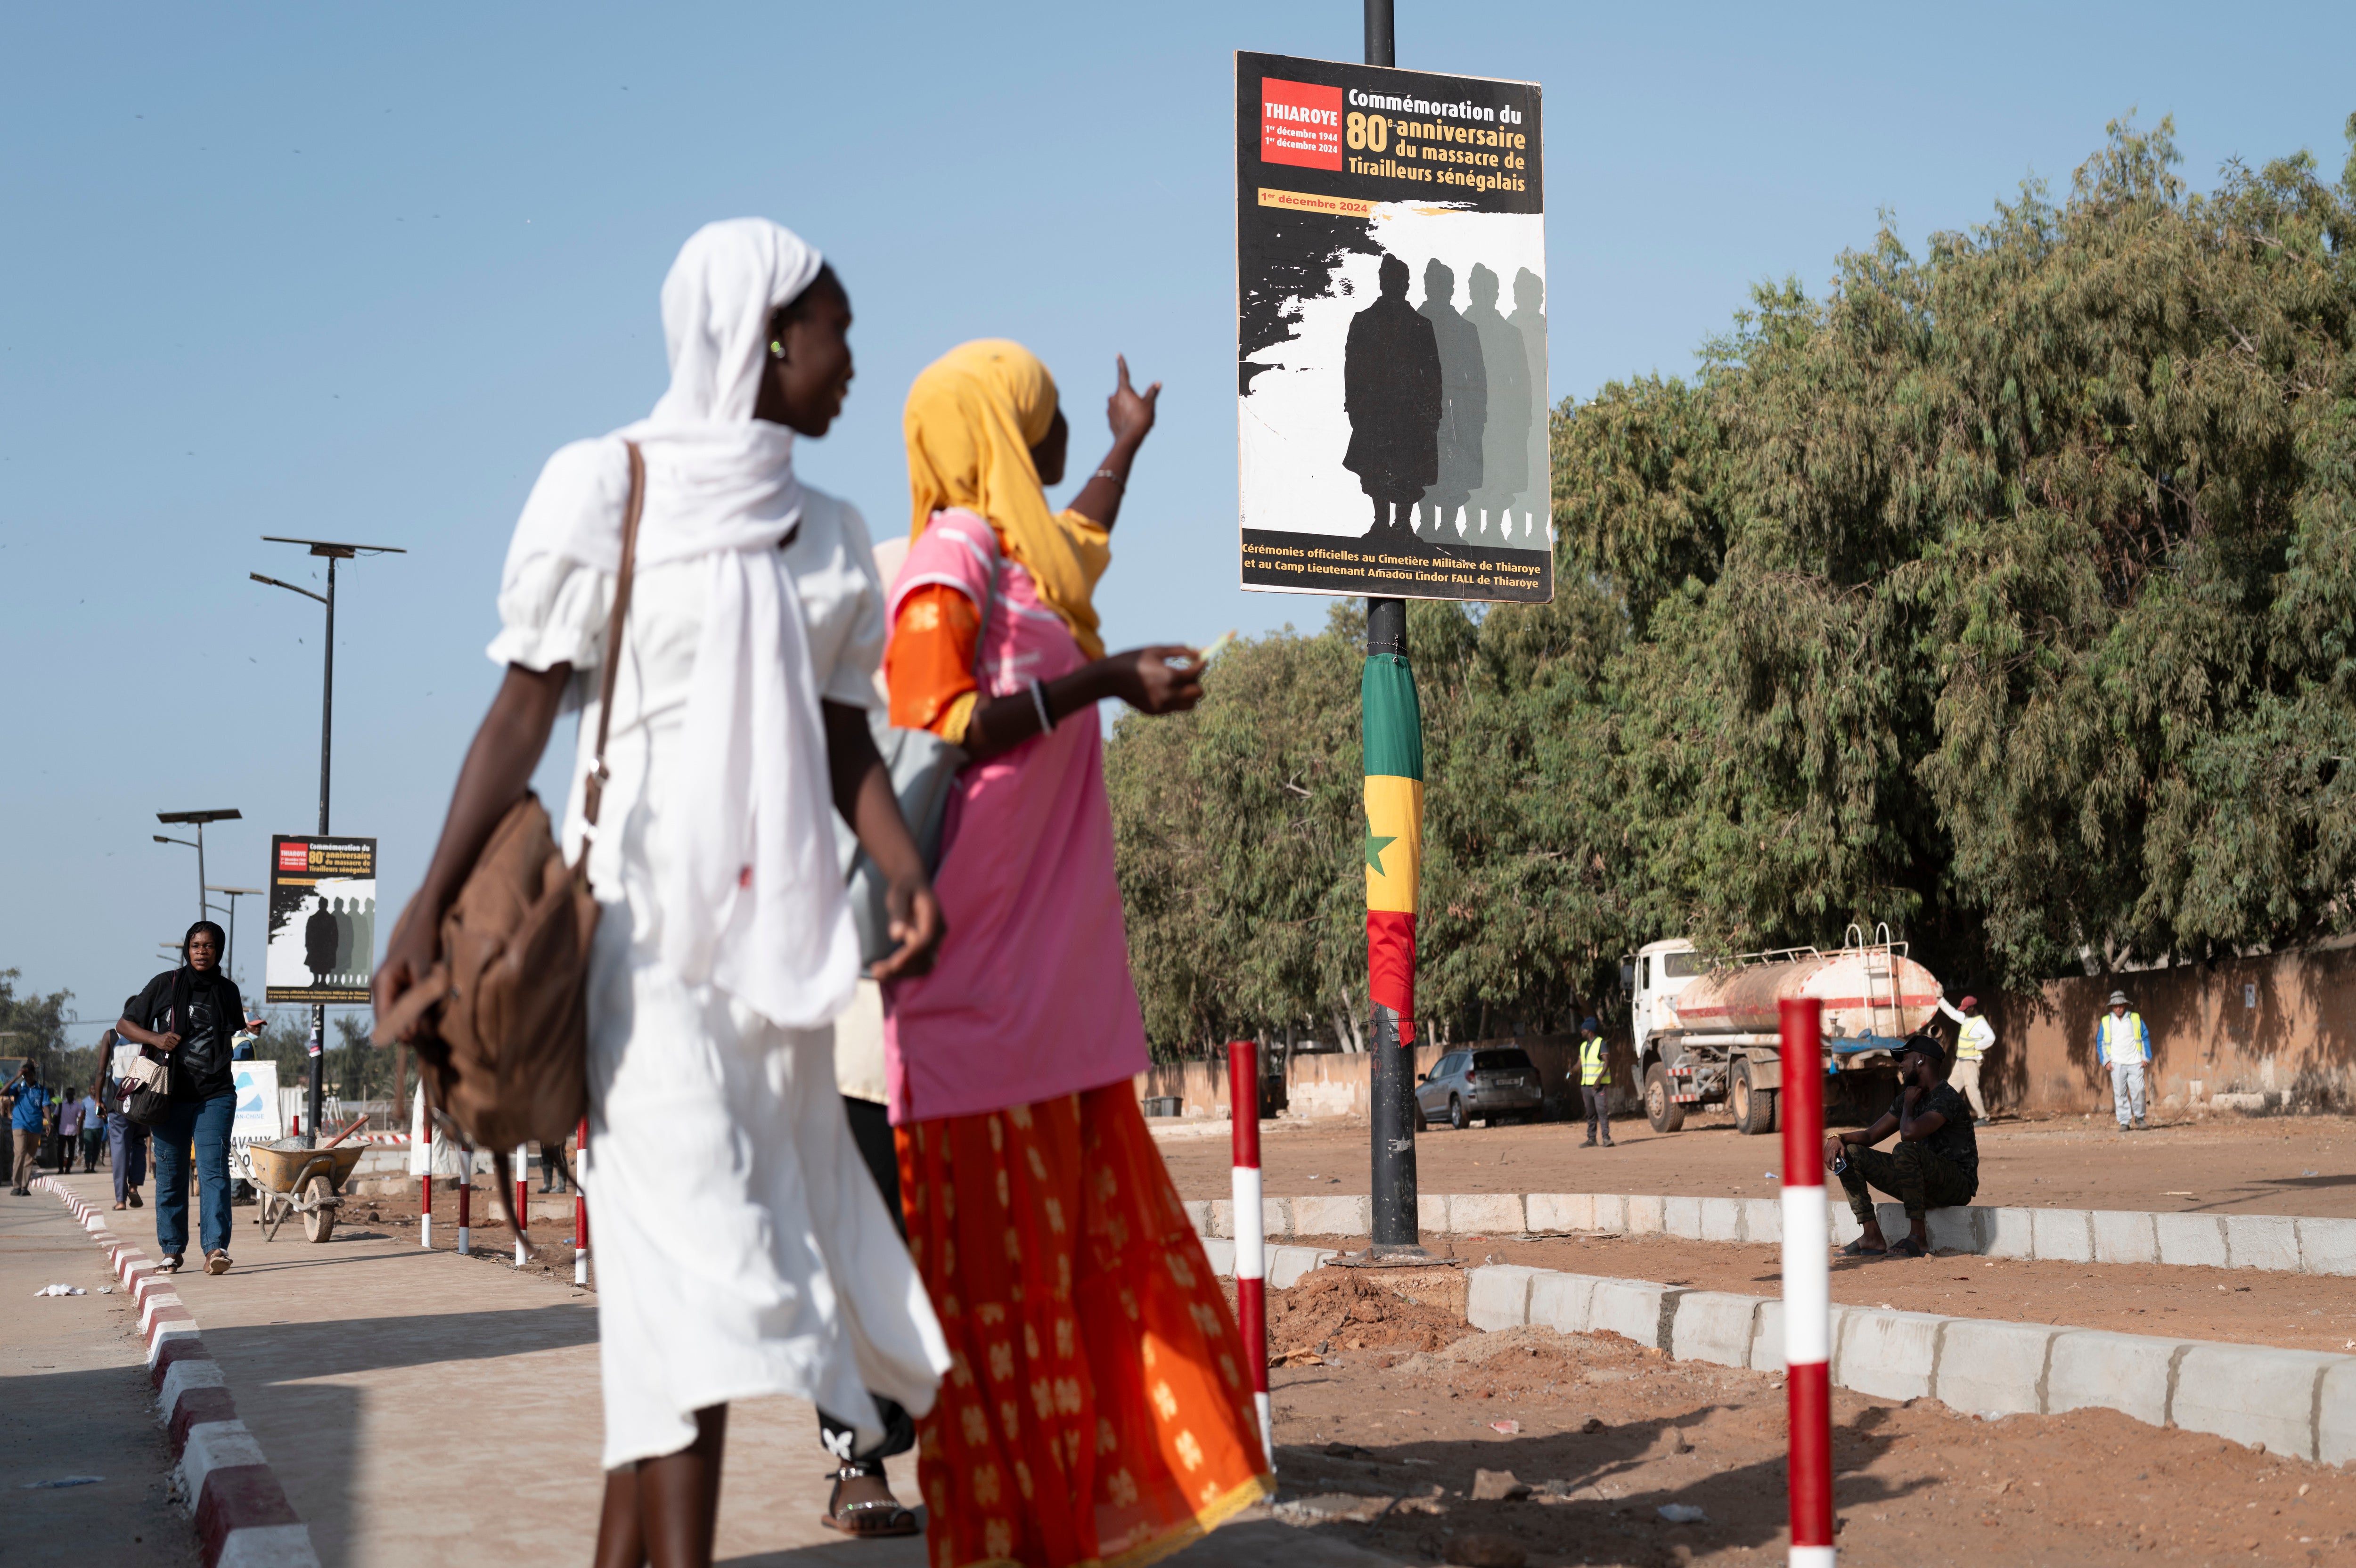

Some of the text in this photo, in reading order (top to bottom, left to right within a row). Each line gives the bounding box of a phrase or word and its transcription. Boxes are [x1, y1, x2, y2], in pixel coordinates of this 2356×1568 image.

[1265, 102, 1337, 126] THIAROYE
[1349, 89, 1521, 124] Commémoration du
[1265, 125, 1337, 142] 1er décembre 1944
[1265, 137, 1337, 154] 1er décembre 2024
[1397, 119, 1525, 149] anniversaire
[1396, 139, 1524, 169] du massacre de
[1349, 156, 1525, 192] Tirailleurs sénégalais
[1261, 193, 1367, 212] 1er décembre 2024
[1243, 544, 1540, 575] Cérémonies officielles au Cimetière Militaire de Thiaroye
[1244, 559, 1538, 589] et au Camp Lieutenant Amadou Lindor FALL de Thiaroye
[310, 843, 360, 851] Commémoration
[326, 851, 371, 859] anniversaire
[339, 866, 370, 874] sénégalais
